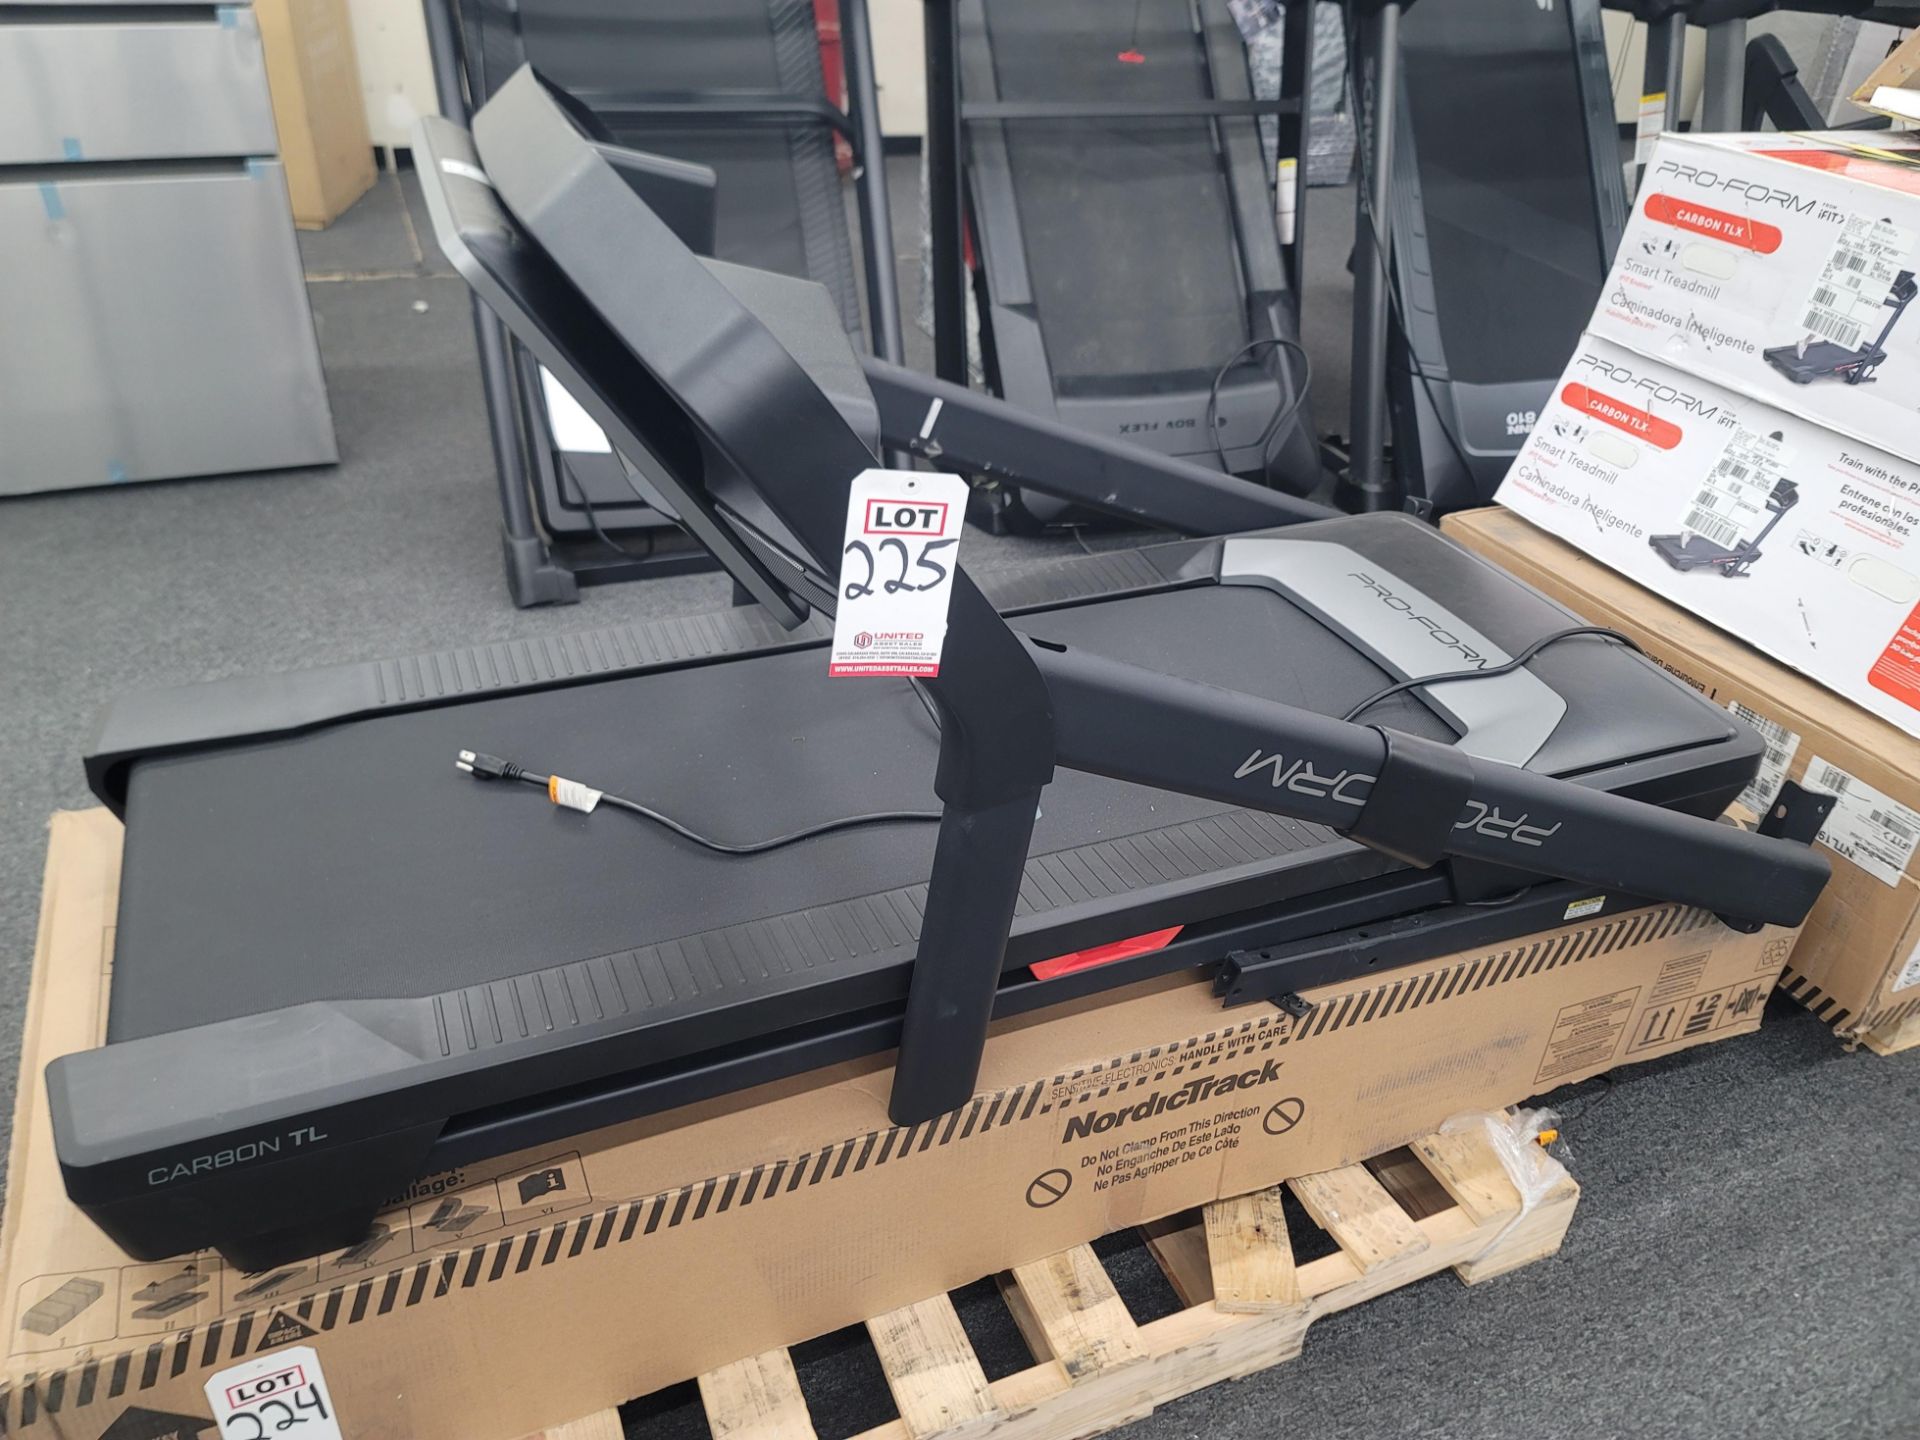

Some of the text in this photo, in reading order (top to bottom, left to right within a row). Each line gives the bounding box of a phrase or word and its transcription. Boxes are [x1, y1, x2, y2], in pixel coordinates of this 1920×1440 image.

[1656, 161, 1816, 215] PRO-FORM
[1676, 208, 1744, 237] CARBON TLX
[1624, 257, 1721, 300] Smart Treadmill
[1611, 291, 1756, 354] Caminadora Inteligente
[1576, 353, 1718, 419] PRO-FORM
[1505, 410, 1536, 425] 810
[1589, 399, 1649, 433] CARBON TLX
[1534, 435, 1619, 485] Smart Treadmill
[1839, 452, 1864, 471] Train
[1865, 464, 1889, 481] with
[1889, 474, 1908, 489] the
[874, 506, 939, 530] LOT
[1580, 497, 1643, 539] Inteligente
[1838, 499, 1911, 537] profesionales.
[1840, 484, 1881, 509] Entrene
[1902, 511, 1920, 526] los
[845, 538, 960, 600] 225
[874, 632, 924, 640] UNITED
[834, 665, 934, 673] WWW.UNITEDASSETSALES.COM
[1695, 993, 1723, 1014] 12
[1104, 1055, 1175, 1084] ELECTRONICS
[1179, 1042, 1224, 1063] HANDLE
[1226, 1033, 1255, 1050] WITH
[1258, 1024, 1288, 1042] CARE
[1061, 1058, 1284, 1145] NordicTrack
[148, 1125, 328, 1186] CARBON TL
[1080, 1105, 1261, 1169] Do Not Clamp From This Direction
[1096, 1124, 1241, 1178] No Enganche De Este Lado
[1093, 1136, 1240, 1193] Ne Pas Agripper De Ce Côté
[236, 1371, 295, 1401] LOT
[226, 1382, 329, 1440] 224
